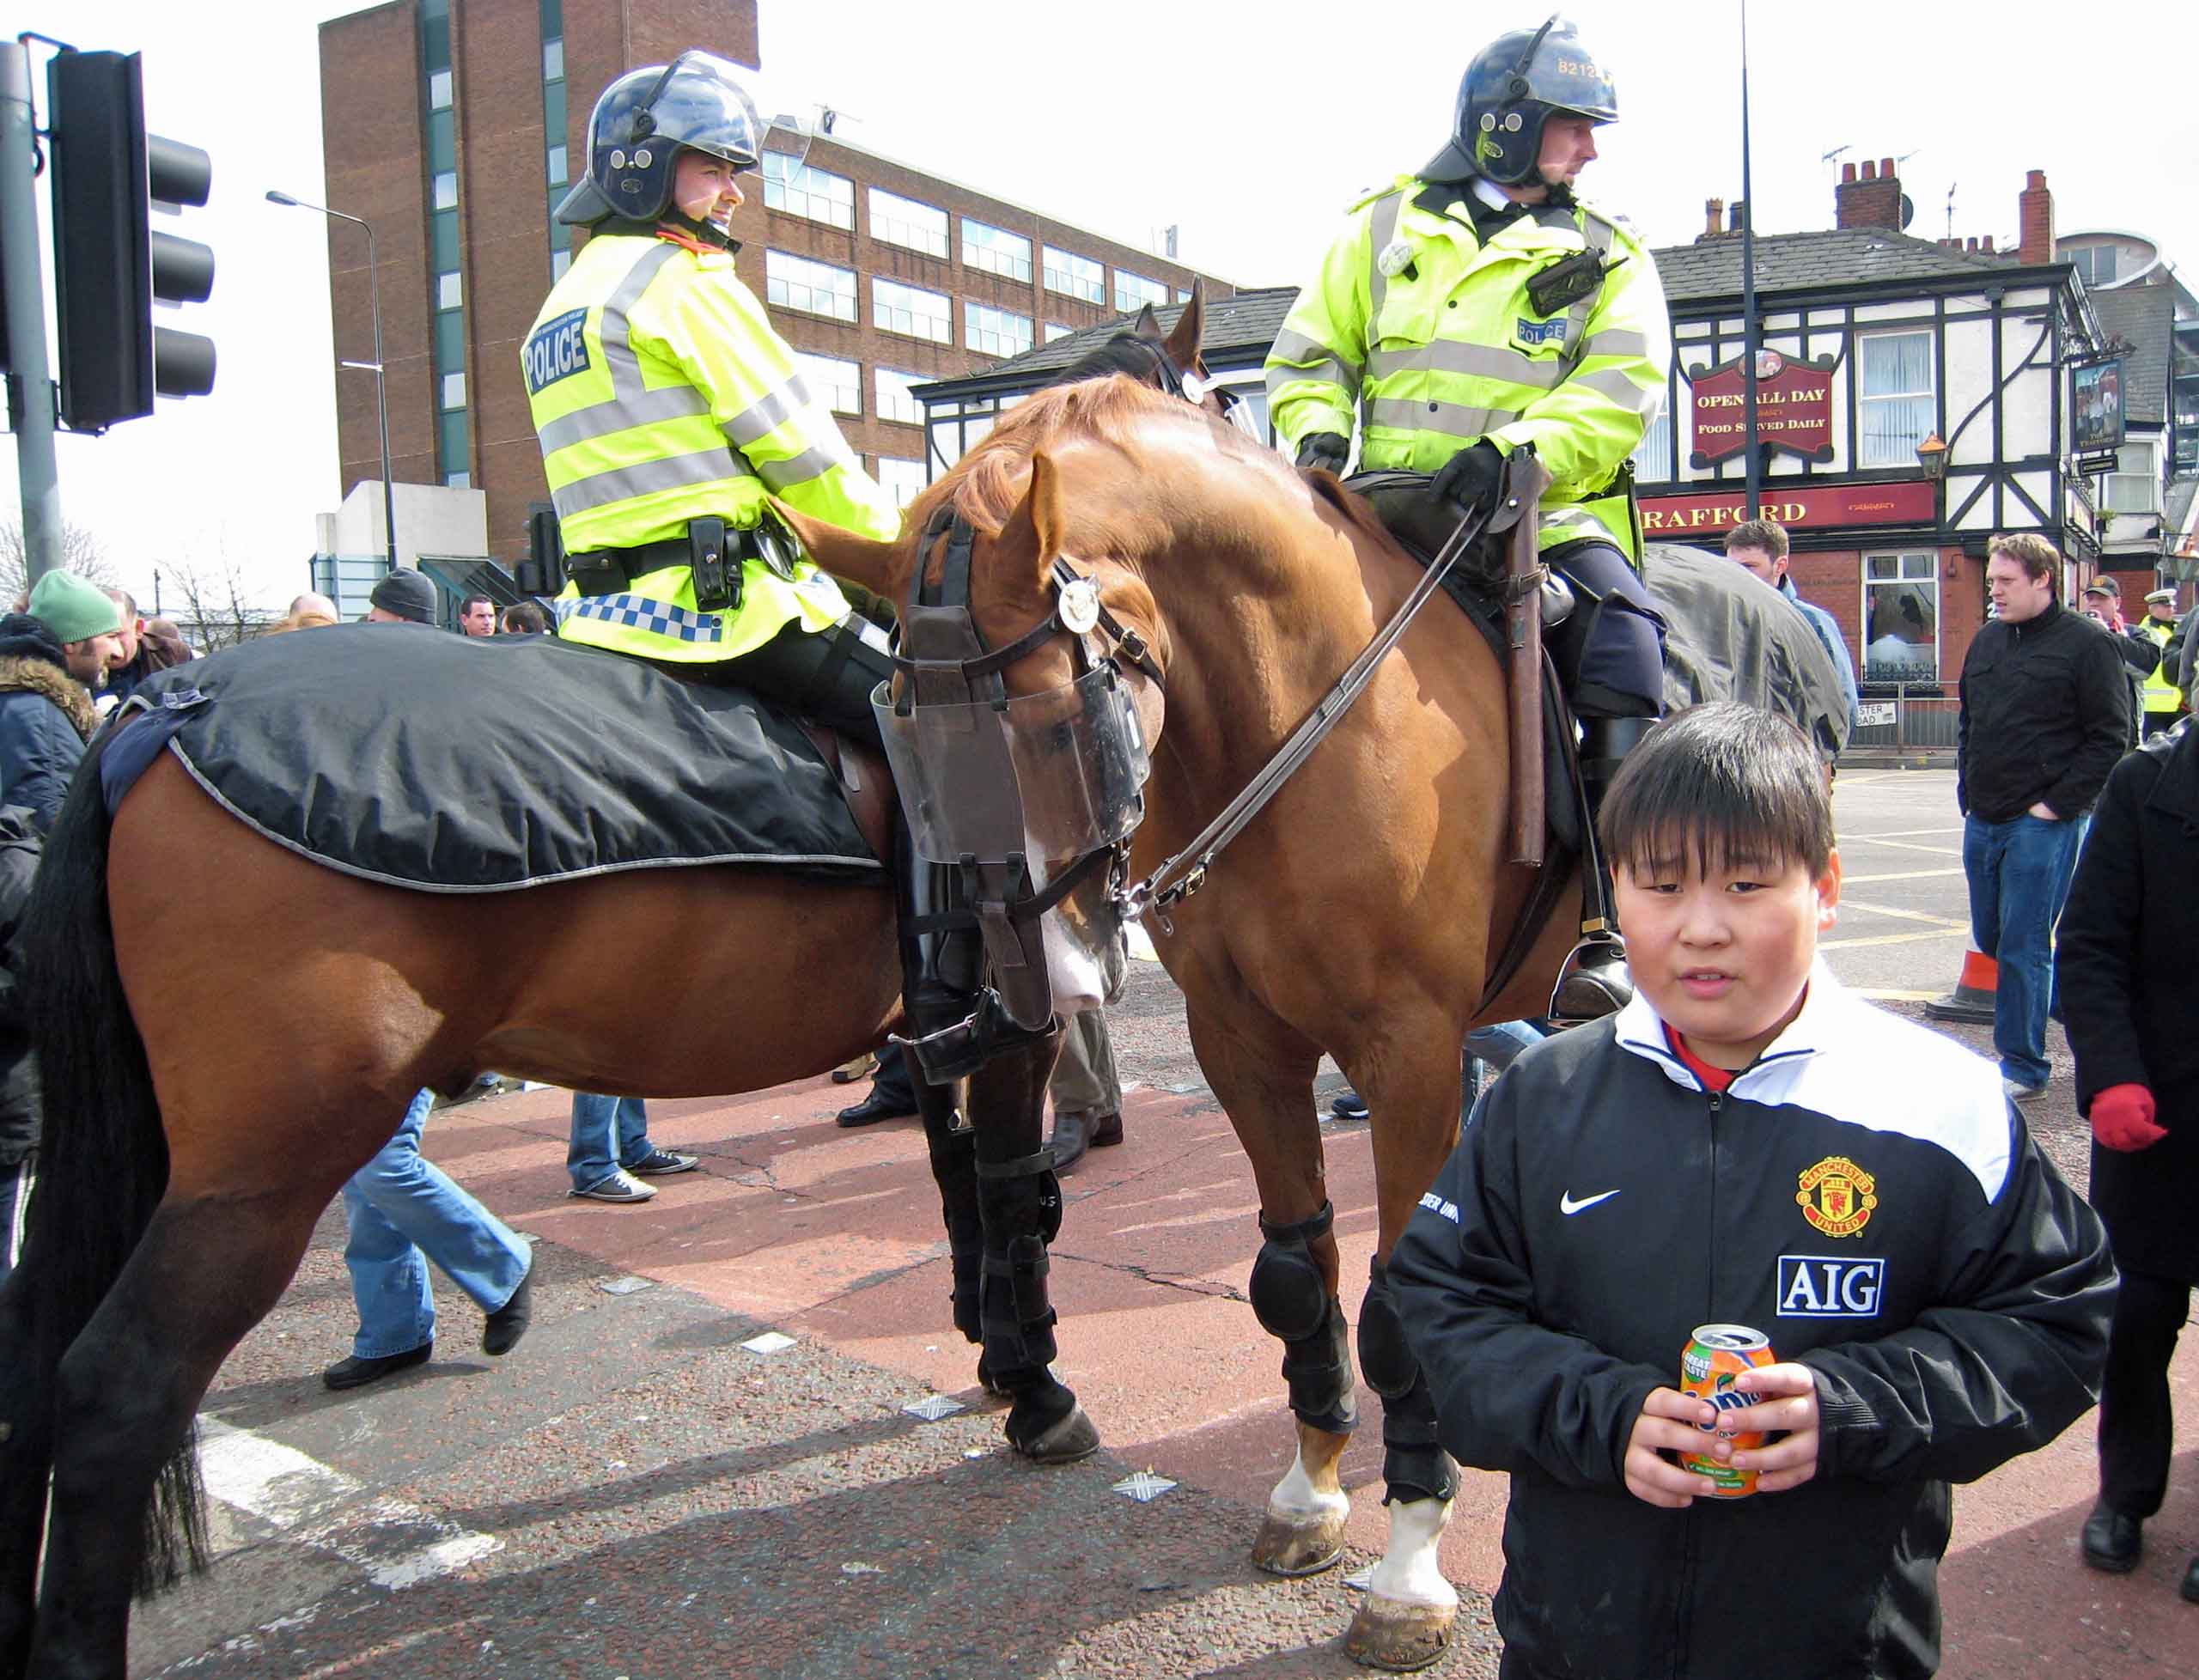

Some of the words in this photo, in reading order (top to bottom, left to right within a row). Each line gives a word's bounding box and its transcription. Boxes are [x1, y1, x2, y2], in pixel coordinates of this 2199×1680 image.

[1519, 325, 1568, 344] POLCE
[525, 320, 586, 393] POLICE
[1696, 394, 1745, 409] OPEN
[1791, 389, 1826, 403] DAY
[1697, 424, 1733, 435] FOOD
[1734, 422, 1784, 433] SVED
[1788, 418, 1826, 429] DAILY
[1856, 705, 1883, 715] STER
[1805, 1163, 1870, 1191] MANCHESTER
[1816, 1215, 1861, 1233] UNITED
[1782, 1261, 1877, 1312] AIG
